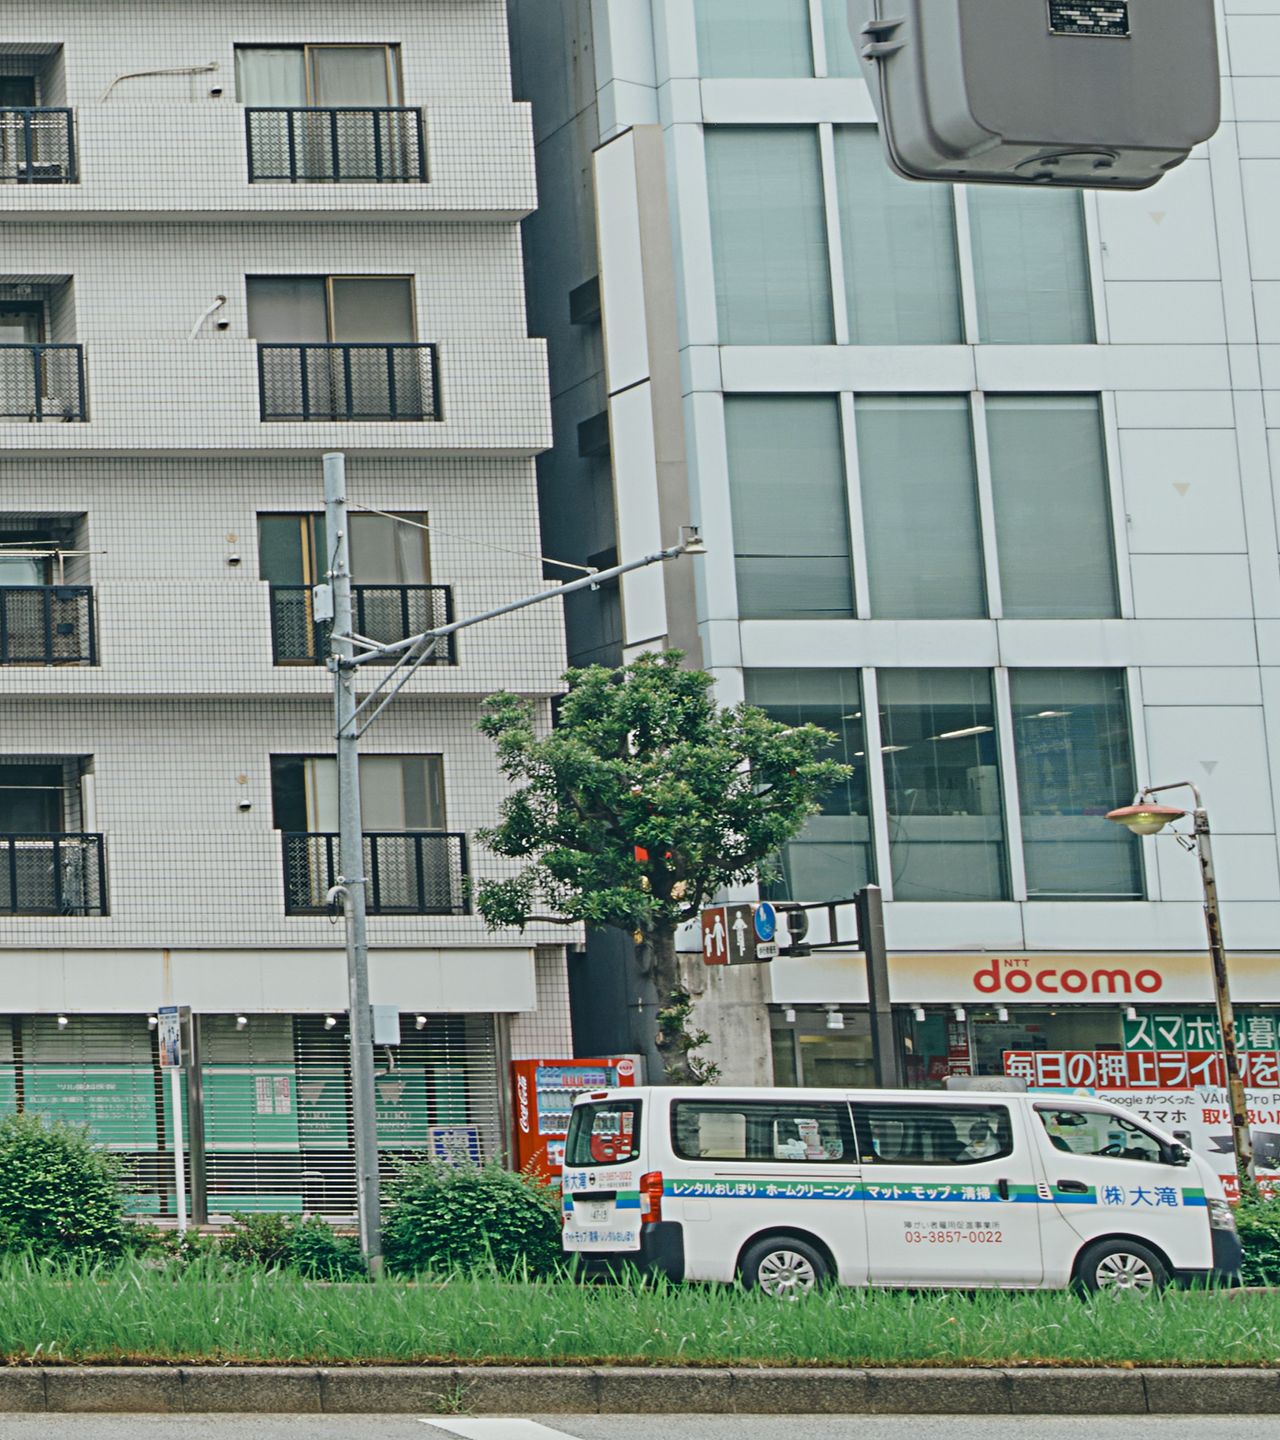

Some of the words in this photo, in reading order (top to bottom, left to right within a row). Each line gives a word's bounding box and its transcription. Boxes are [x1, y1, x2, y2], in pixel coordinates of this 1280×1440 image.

[1003, 959, 1030, 968] NTT
[973, 959, 1163, 993] docomo
[1127, 1015, 1280, 1048] スマホ暮
[1100, 1185, 1179, 1207] (株)大滝
[904, 1230, 1003, 1244] 03-3857-0022
